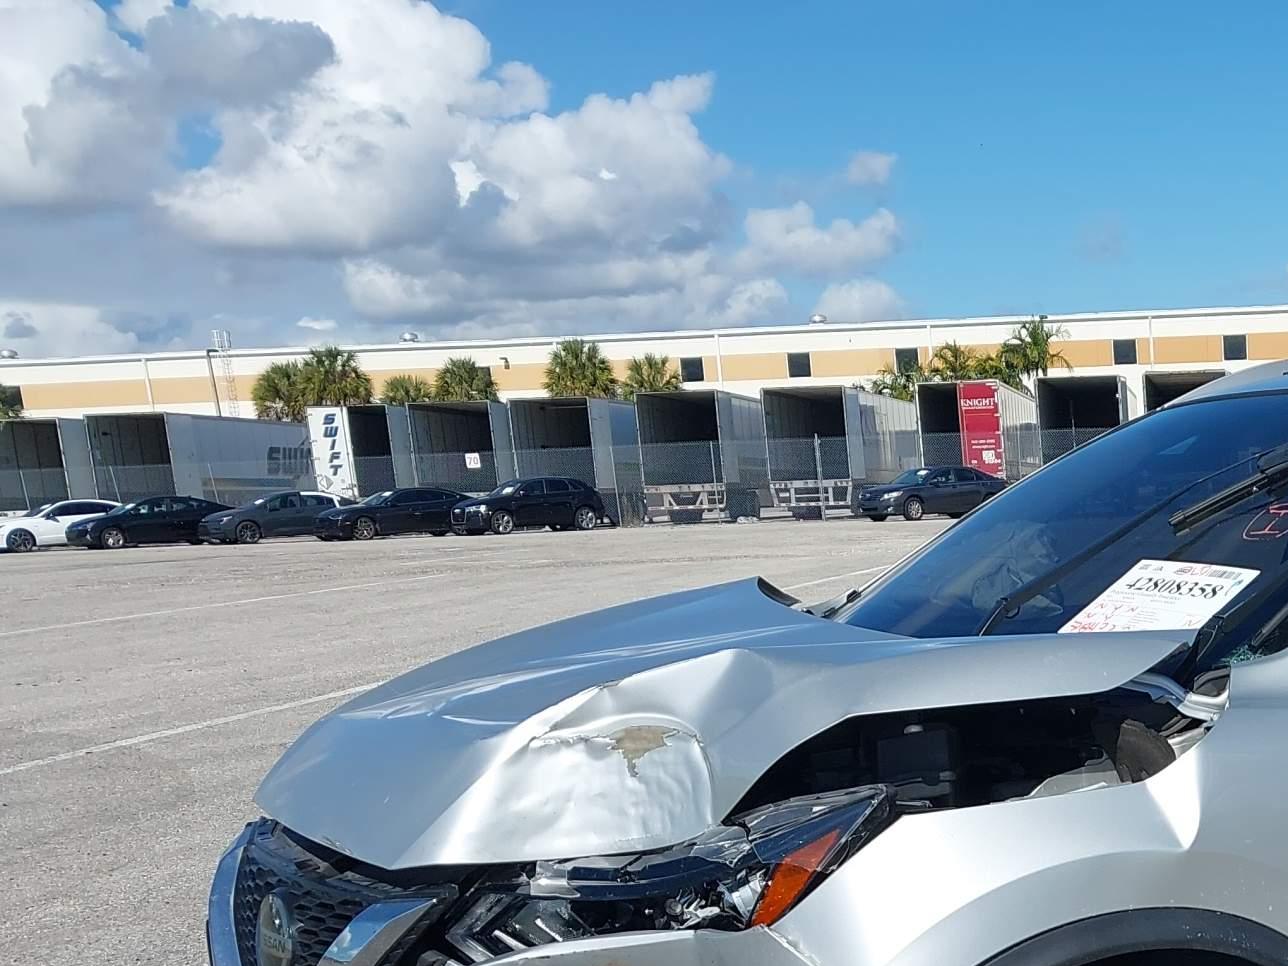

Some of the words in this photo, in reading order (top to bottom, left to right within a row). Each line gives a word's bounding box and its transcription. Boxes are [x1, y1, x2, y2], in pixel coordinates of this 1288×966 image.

[961, 398, 995, 407] KNIGHT
[322, 413, 343, 476] SWIFT
[466, 456, 479, 466] 70
[1126, 577, 1224, 600] 42808358
